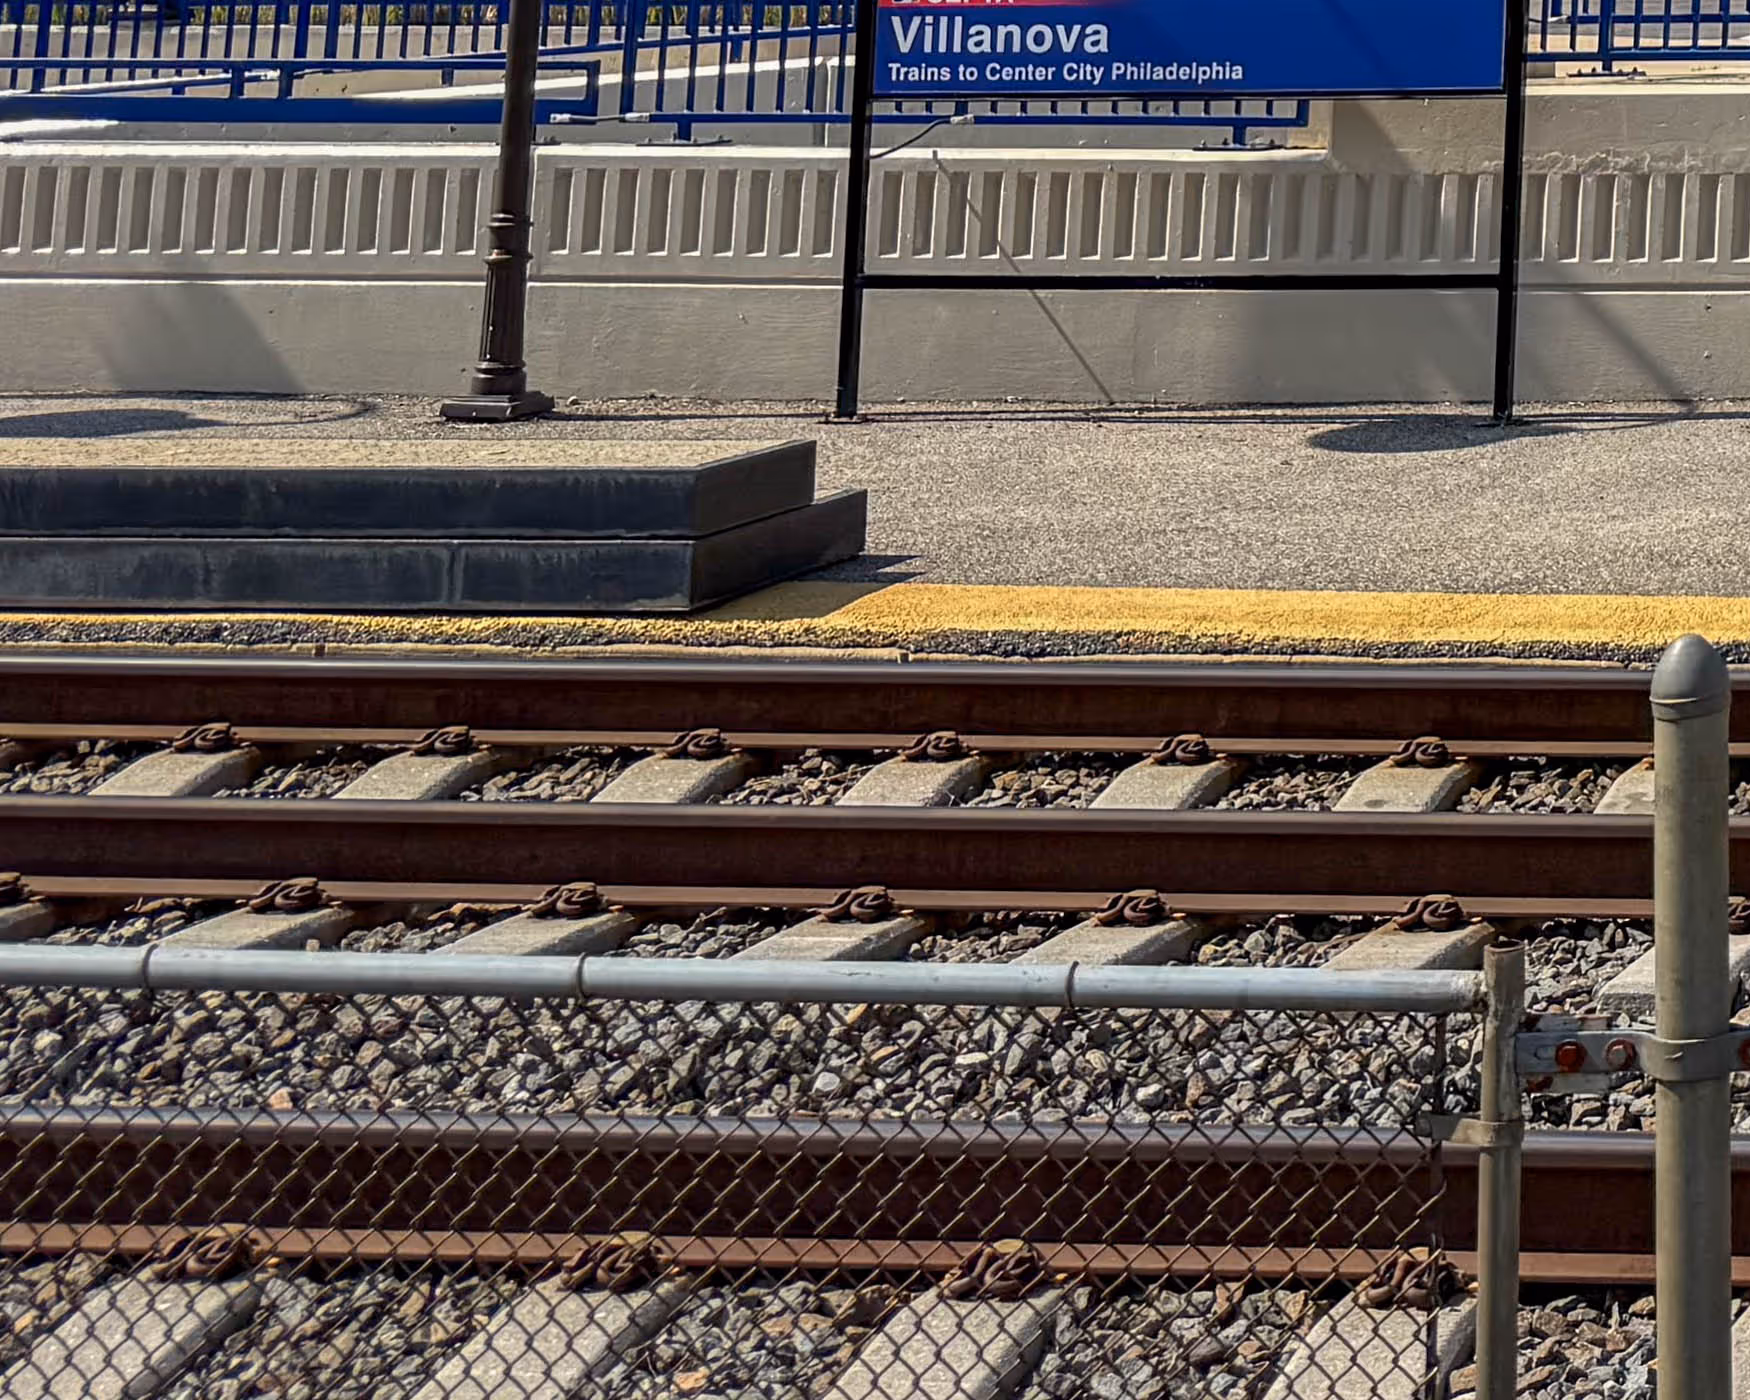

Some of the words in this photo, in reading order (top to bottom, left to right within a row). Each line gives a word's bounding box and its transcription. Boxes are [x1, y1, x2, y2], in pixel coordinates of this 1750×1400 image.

[891, 14, 1110, 55] Villanova
[888, 62, 951, 82] Trains
[958, 63, 978, 82] to
[985, 62, 1056, 82] Center
[1063, 62, 1105, 86] City
[1111, 61, 1243, 85] Philadelphia
